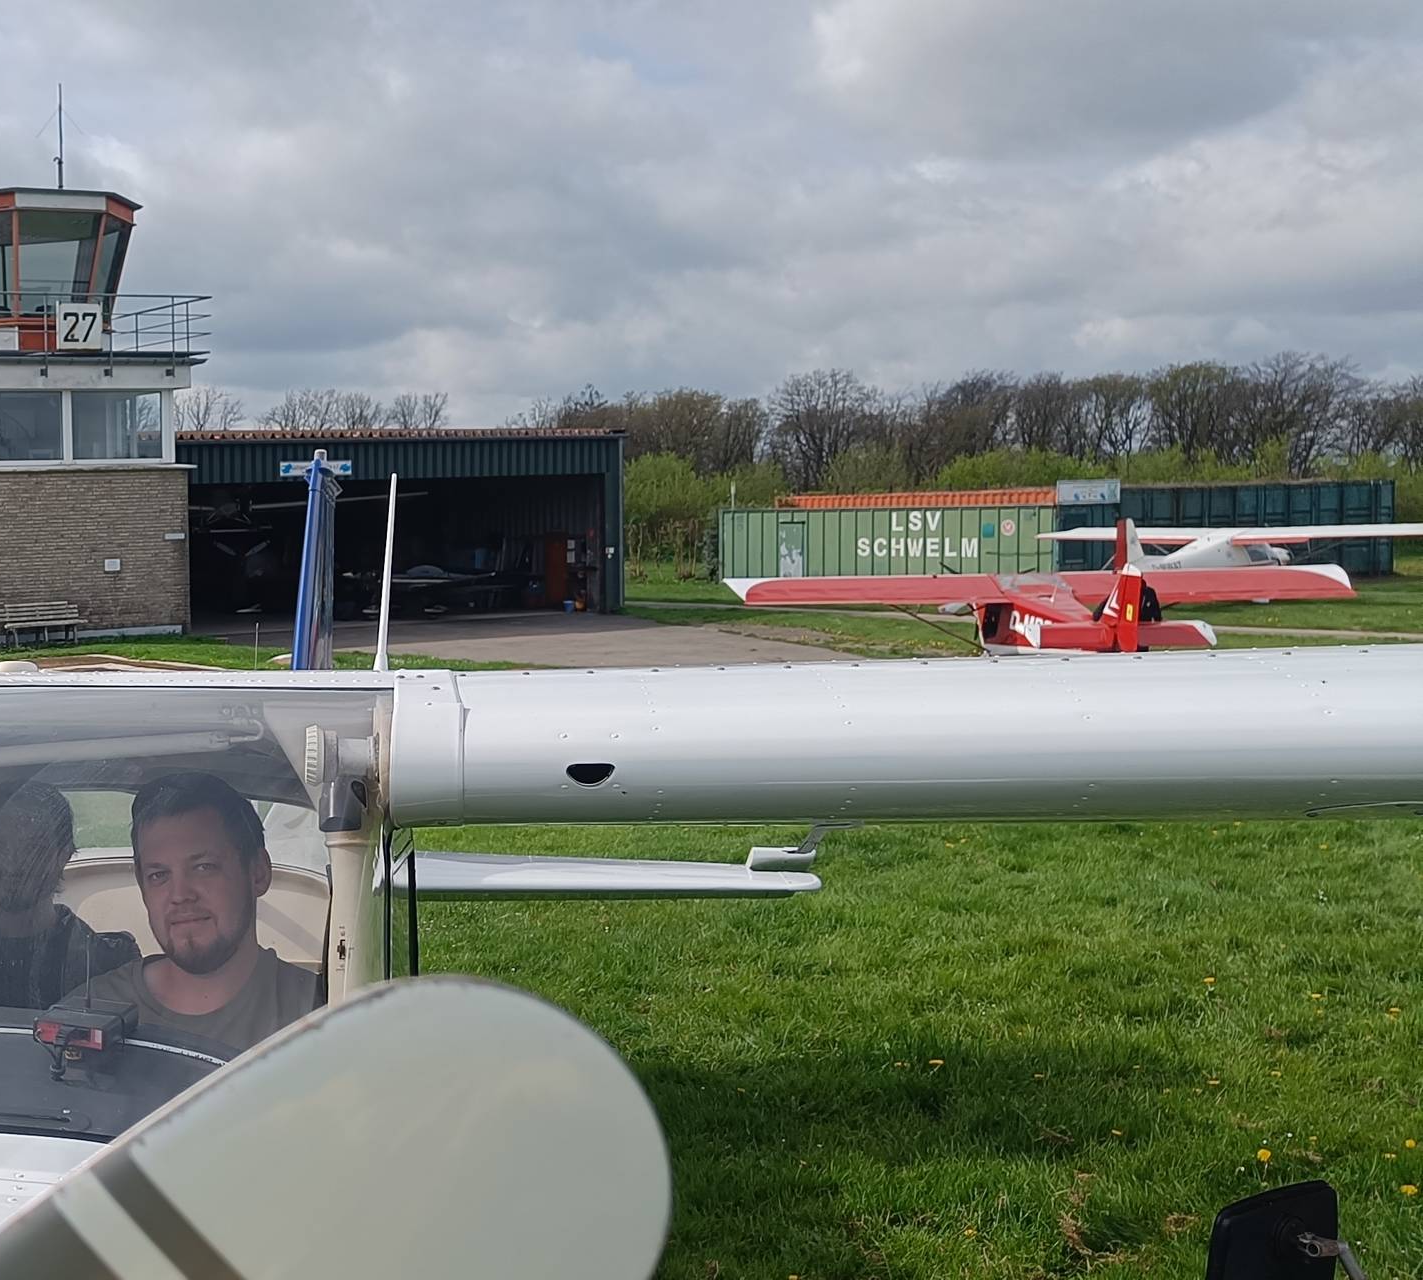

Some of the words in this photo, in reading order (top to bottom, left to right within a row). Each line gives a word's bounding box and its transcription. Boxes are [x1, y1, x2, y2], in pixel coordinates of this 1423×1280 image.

[63, 312, 97, 342] 27
[891, 511, 941, 532] LSV
[857, 537, 978, 558] SCHWELM
